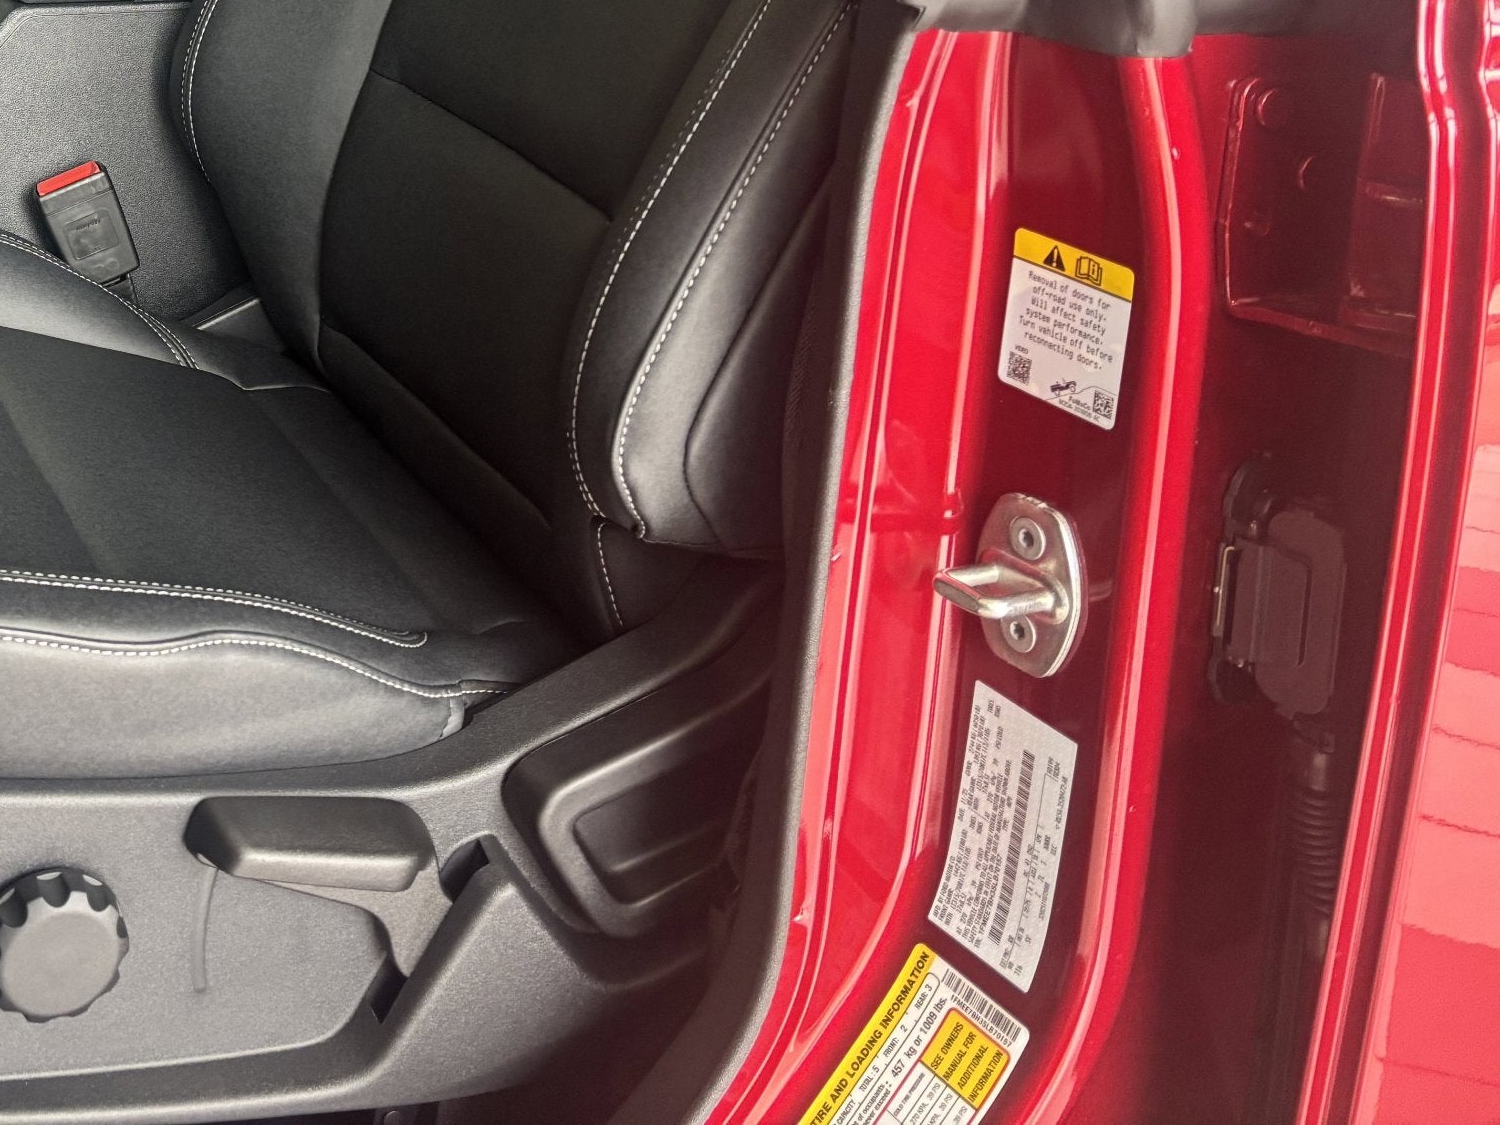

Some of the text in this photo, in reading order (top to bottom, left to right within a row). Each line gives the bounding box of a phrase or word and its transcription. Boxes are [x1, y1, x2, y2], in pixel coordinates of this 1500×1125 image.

[1028, 270, 1110, 310] Removal of doors for
[1032, 284, 1066, 305] off-road
[1069, 301, 1081, 312] use
[1025, 307, 1050, 325] system
[1031, 296, 1106, 336] Will affect safety
[1018, 315, 1113, 363] Turn vehicle off before
[1024, 329, 1073, 359] reconnecting
[827, 1076, 849, 1103] AND
[845, 1028, 883, 1078] LOADING
[879, 950, 929, 1029] INFORMATION
[871, 1064, 879, 1073] 5
[899, 1023, 907, 1032] 2
[924, 983, 932, 991] 3
[889, 993, 948, 1079] 457 kg or 1009 lbs.
[930, 1021, 964, 1070] SEE OWNERS
[942, 1031, 976, 1081] MANUAL FOR
[956, 1042, 988, 1089] ADDITIONAL
[967, 1049, 1003, 1102] INFORMATION
[861, 1082, 885, 1114] occupants
[873, 1087, 891, 1110] exceed
[931, 1082, 940, 1092] PSI
[943, 1092, 953, 1103] PSI
